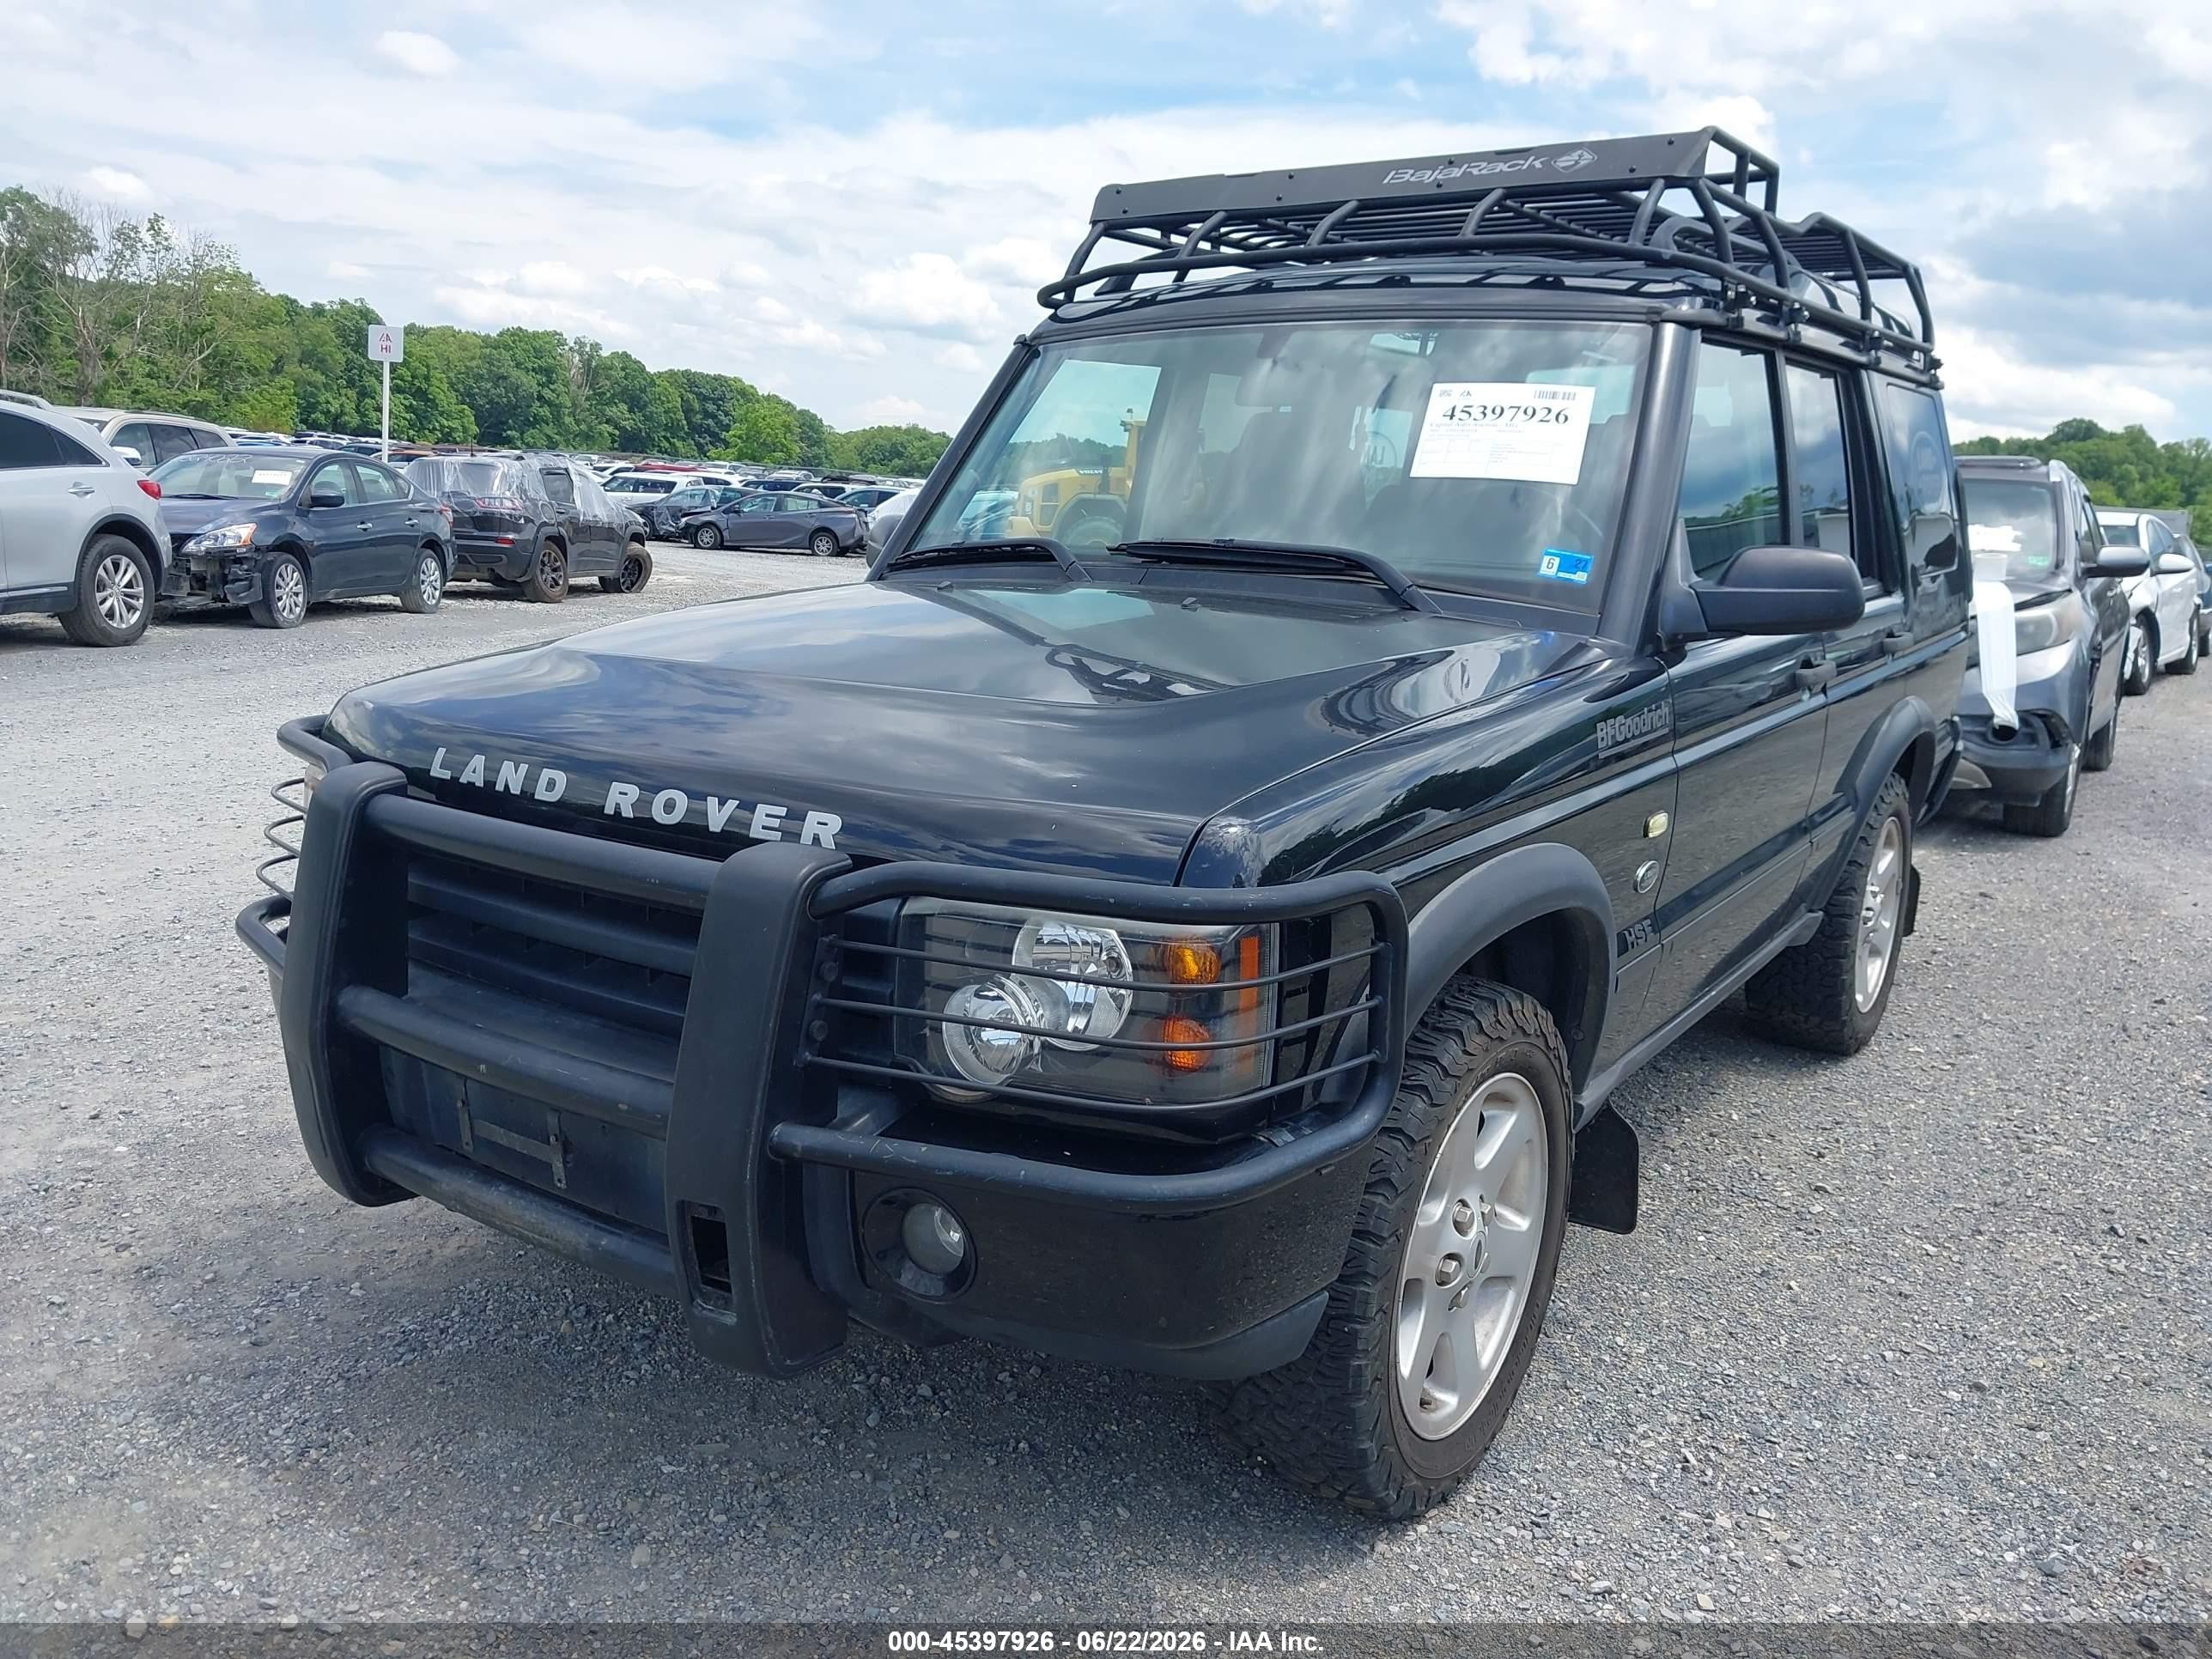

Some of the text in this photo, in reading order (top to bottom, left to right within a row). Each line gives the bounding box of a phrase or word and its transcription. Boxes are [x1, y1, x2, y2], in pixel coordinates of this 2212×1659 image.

[1382, 155, 1548, 184] BajaRack
[1443, 404, 1570, 425] 45397926
[1547, 557, 1589, 570] 6 27
[1595, 702, 1669, 750] BFGoodrich
[428, 746, 842, 850] LAND ROVER
